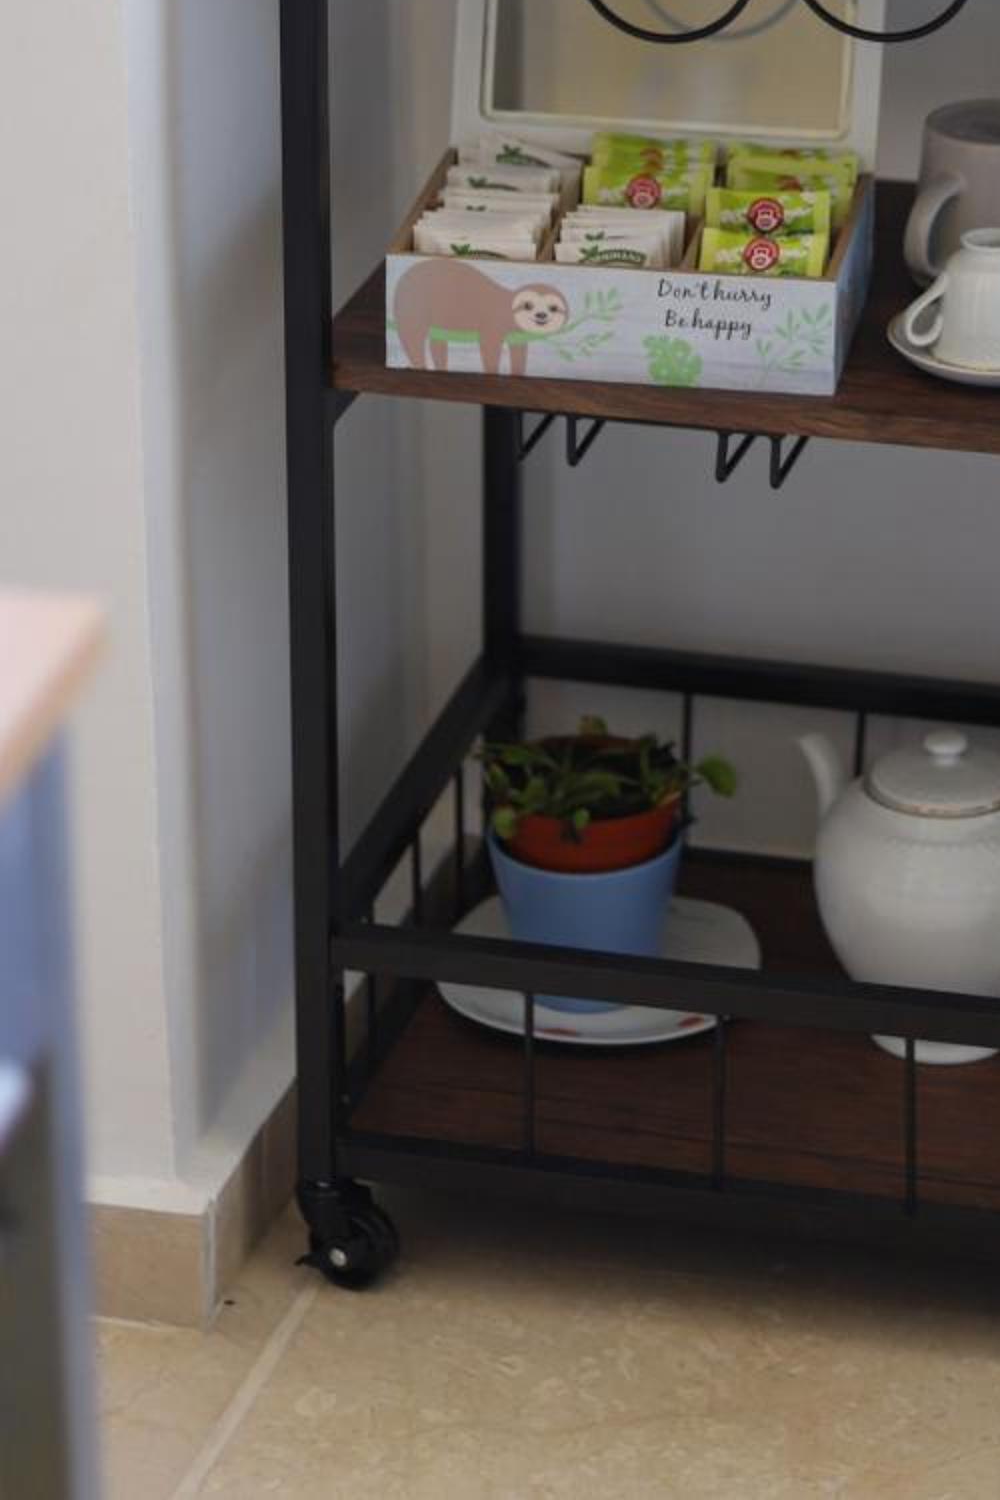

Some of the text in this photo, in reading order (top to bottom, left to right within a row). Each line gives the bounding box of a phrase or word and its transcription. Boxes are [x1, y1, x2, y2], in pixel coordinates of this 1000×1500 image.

[657, 278, 771, 311] Don't hurry
[665, 307, 751, 340] Be happy
